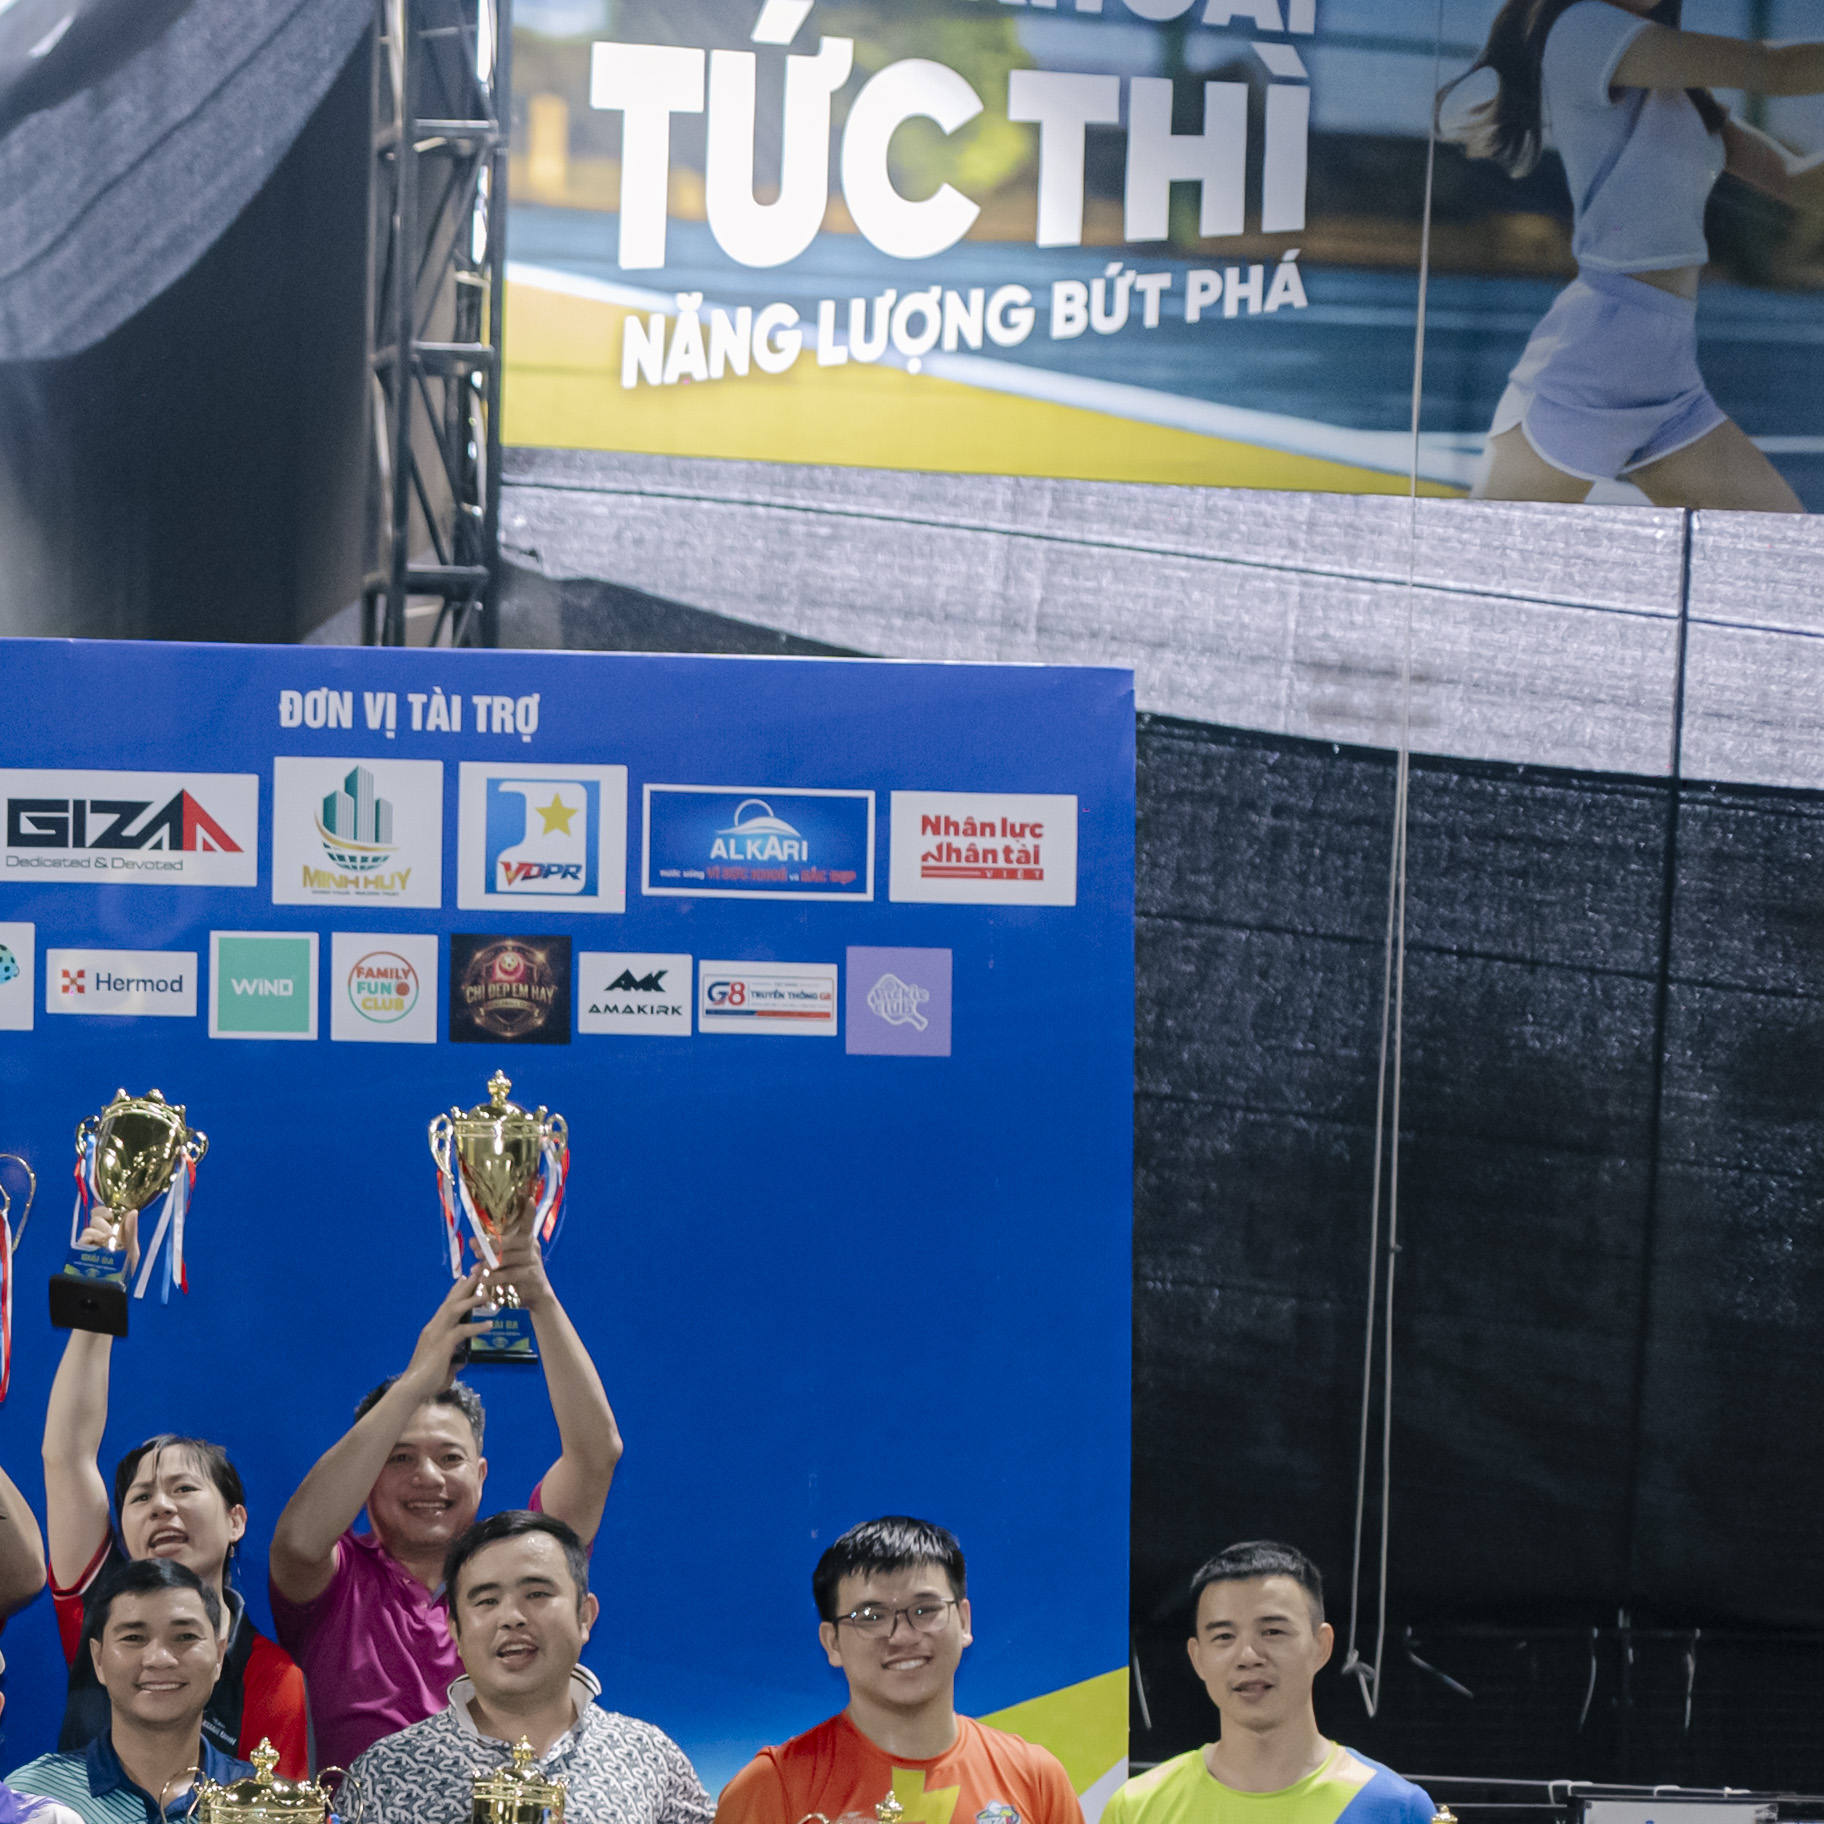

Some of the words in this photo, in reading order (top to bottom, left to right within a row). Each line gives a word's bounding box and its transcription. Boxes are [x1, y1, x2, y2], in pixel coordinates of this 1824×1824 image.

[590, 3, 983, 269] TỨC
[1008, 40, 1311, 248] THÌ
[621, 289, 804, 389] NĂNG
[819, 281, 1035, 375] LƯỢNG
[1049, 260, 1173, 341] BỨT
[1185, 249, 1309, 323] PHÁ
[279, 687, 353, 729] ĐƠN
[364, 691, 398, 738] VỊ
[407, 686, 462, 733] TÀI
[472, 693, 541, 742] TRỢ
[5, 787, 245, 854] GIZA
[920, 814, 996, 838] Nhân
[1001, 816, 1044, 844] lực
[710, 834, 808, 862] ALKARI
[1003, 838, 1041, 865] tài
[5, 854, 91, 870] Dedicated
[94, 857, 108, 870] &
[110, 857, 185, 872] Devoted
[302, 865, 360, 890] MINH
[363, 866, 412, 892] HUY
[95, 972, 184, 994] Hermod
[356, 965, 410, 981] FAMILY
[231, 978, 294, 997] WIND
[356, 981, 392, 995] FUN
[707, 980, 746, 1007] G8
[361, 996, 405, 1012] CLUB
[588, 1003, 683, 1016] AMAKIRK
